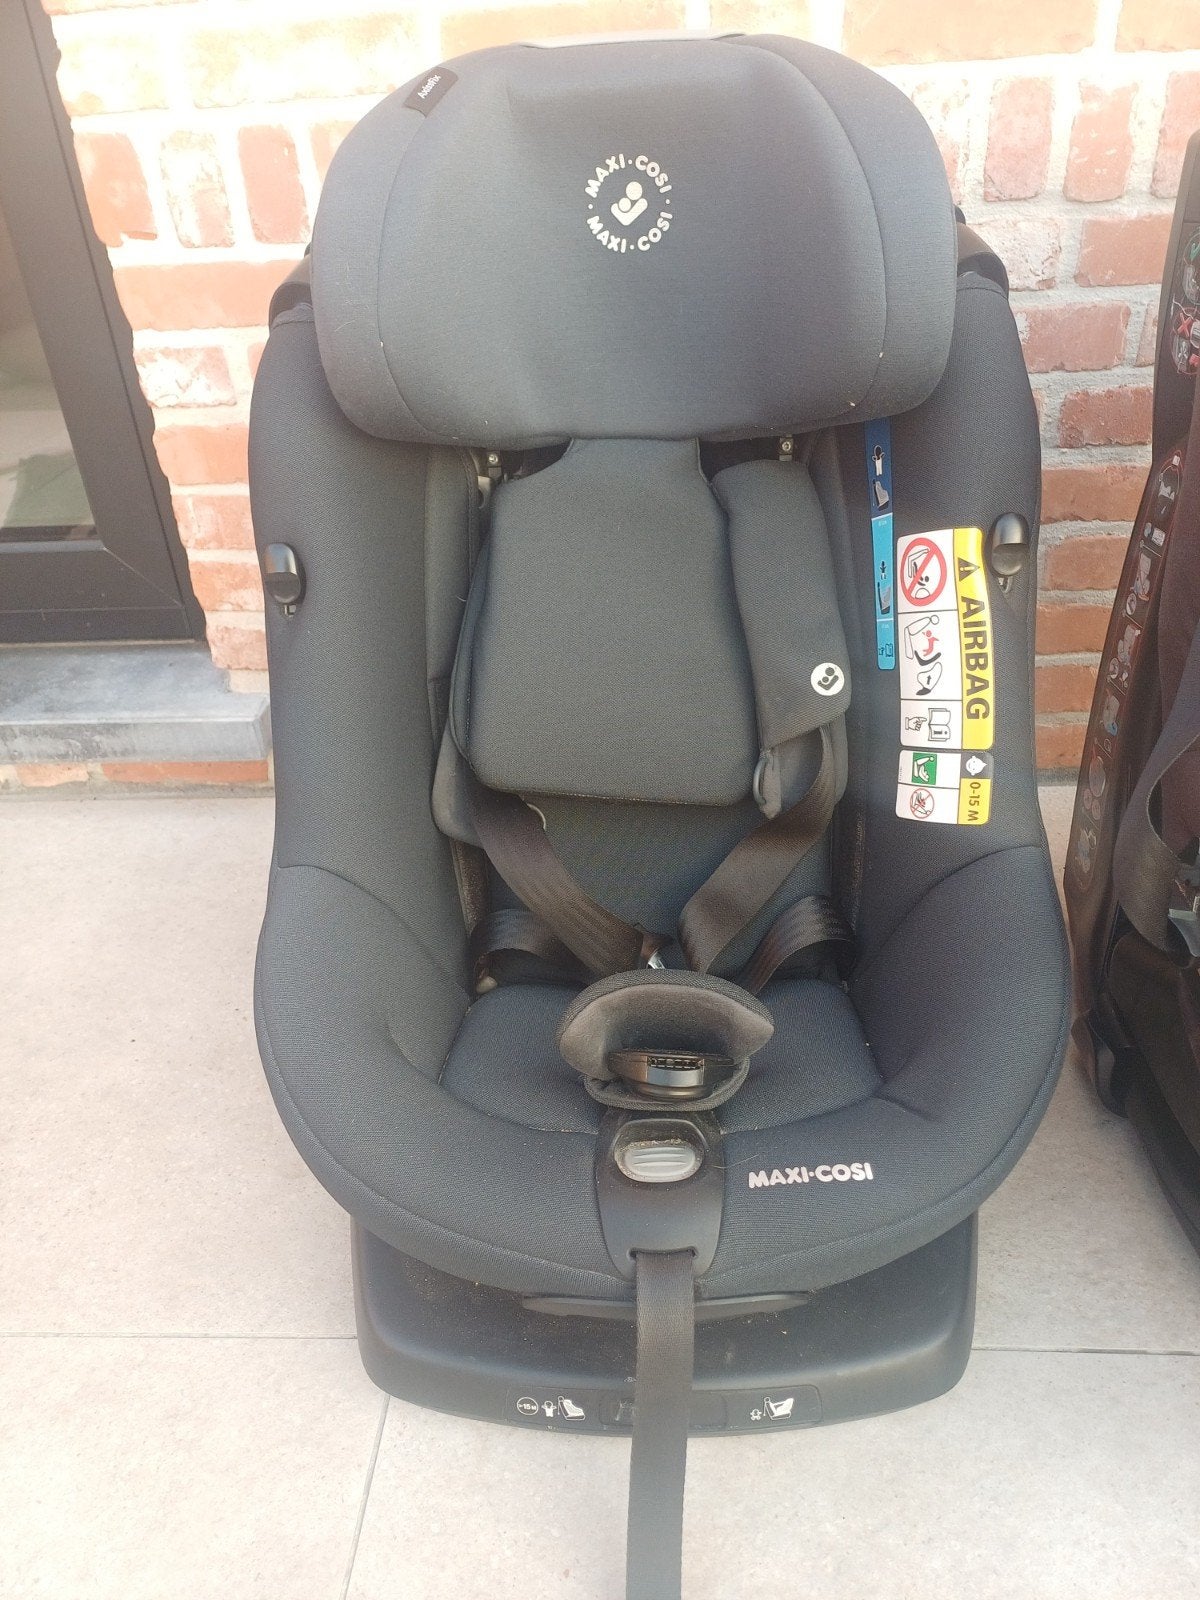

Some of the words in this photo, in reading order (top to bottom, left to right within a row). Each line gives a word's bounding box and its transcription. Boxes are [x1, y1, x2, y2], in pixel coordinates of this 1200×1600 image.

[960, 595, 991, 720] AIRBAG
[968, 781, 982, 807] 0-15
[967, 809, 980, 822] M
